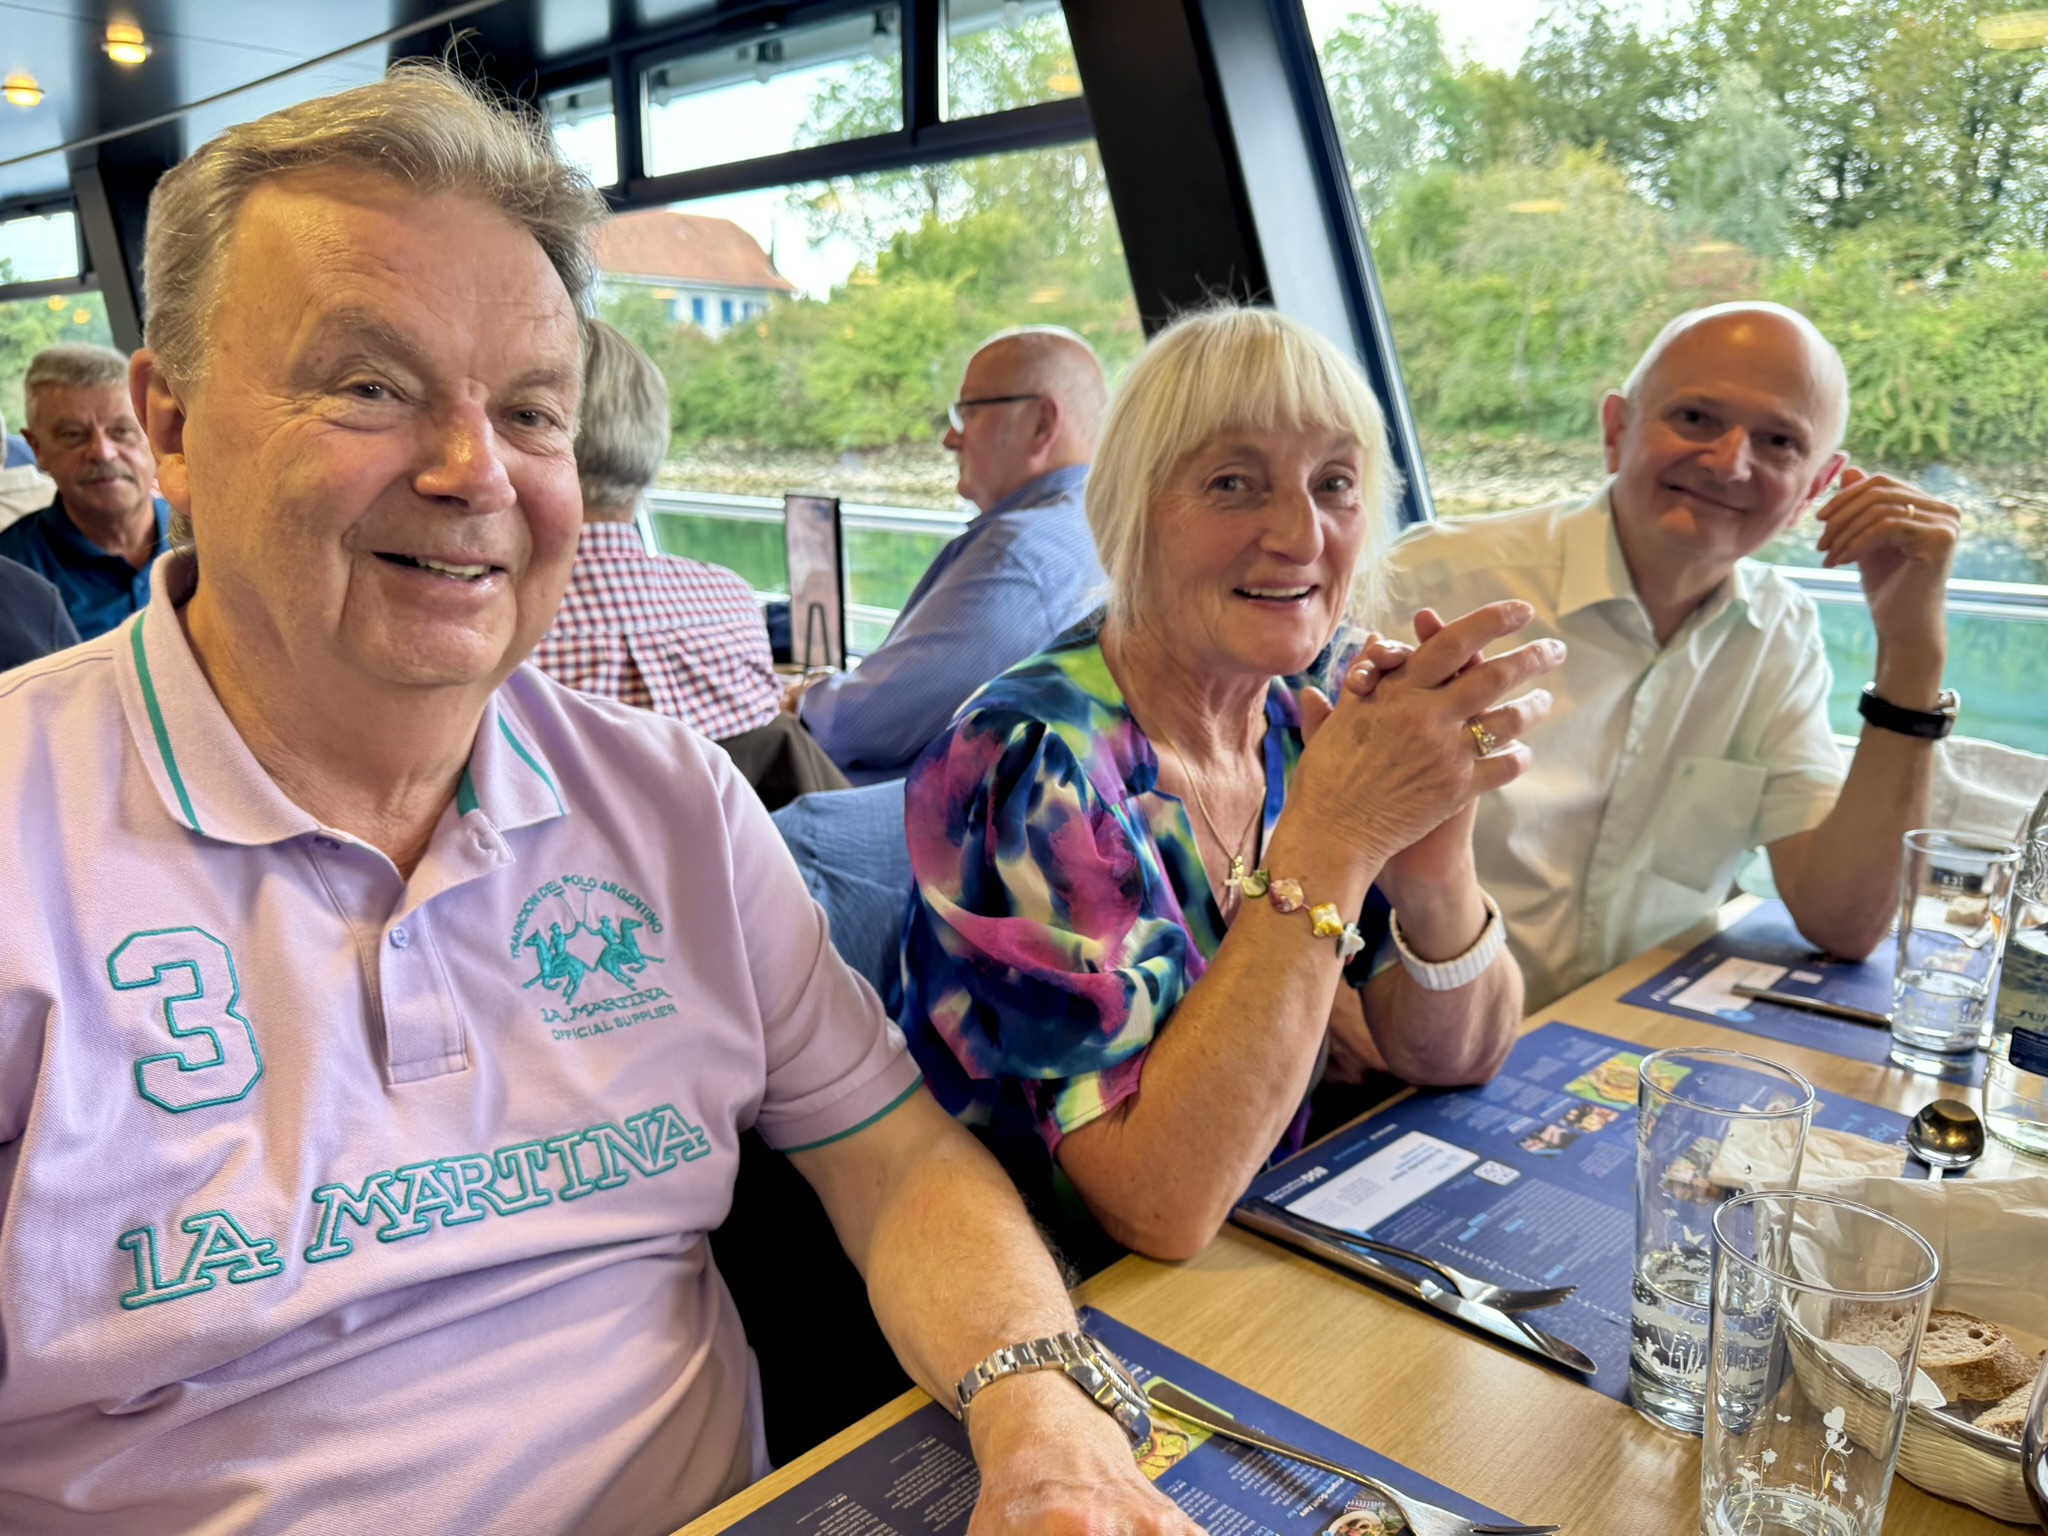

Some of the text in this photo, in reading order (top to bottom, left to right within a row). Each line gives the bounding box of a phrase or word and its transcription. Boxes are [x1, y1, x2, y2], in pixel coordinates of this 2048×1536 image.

[537, 881, 566, 899] DEL
[561, 874, 598, 890] POLO
[600, 880, 664, 934] ARGENTINO
[107, 925, 264, 1114] 3
[551, 1002, 679, 1042] OFFICIAL SUPPLIER
[570, 986, 673, 1022] MARTINA
[118, 1103, 713, 1311] LA MARTINA
